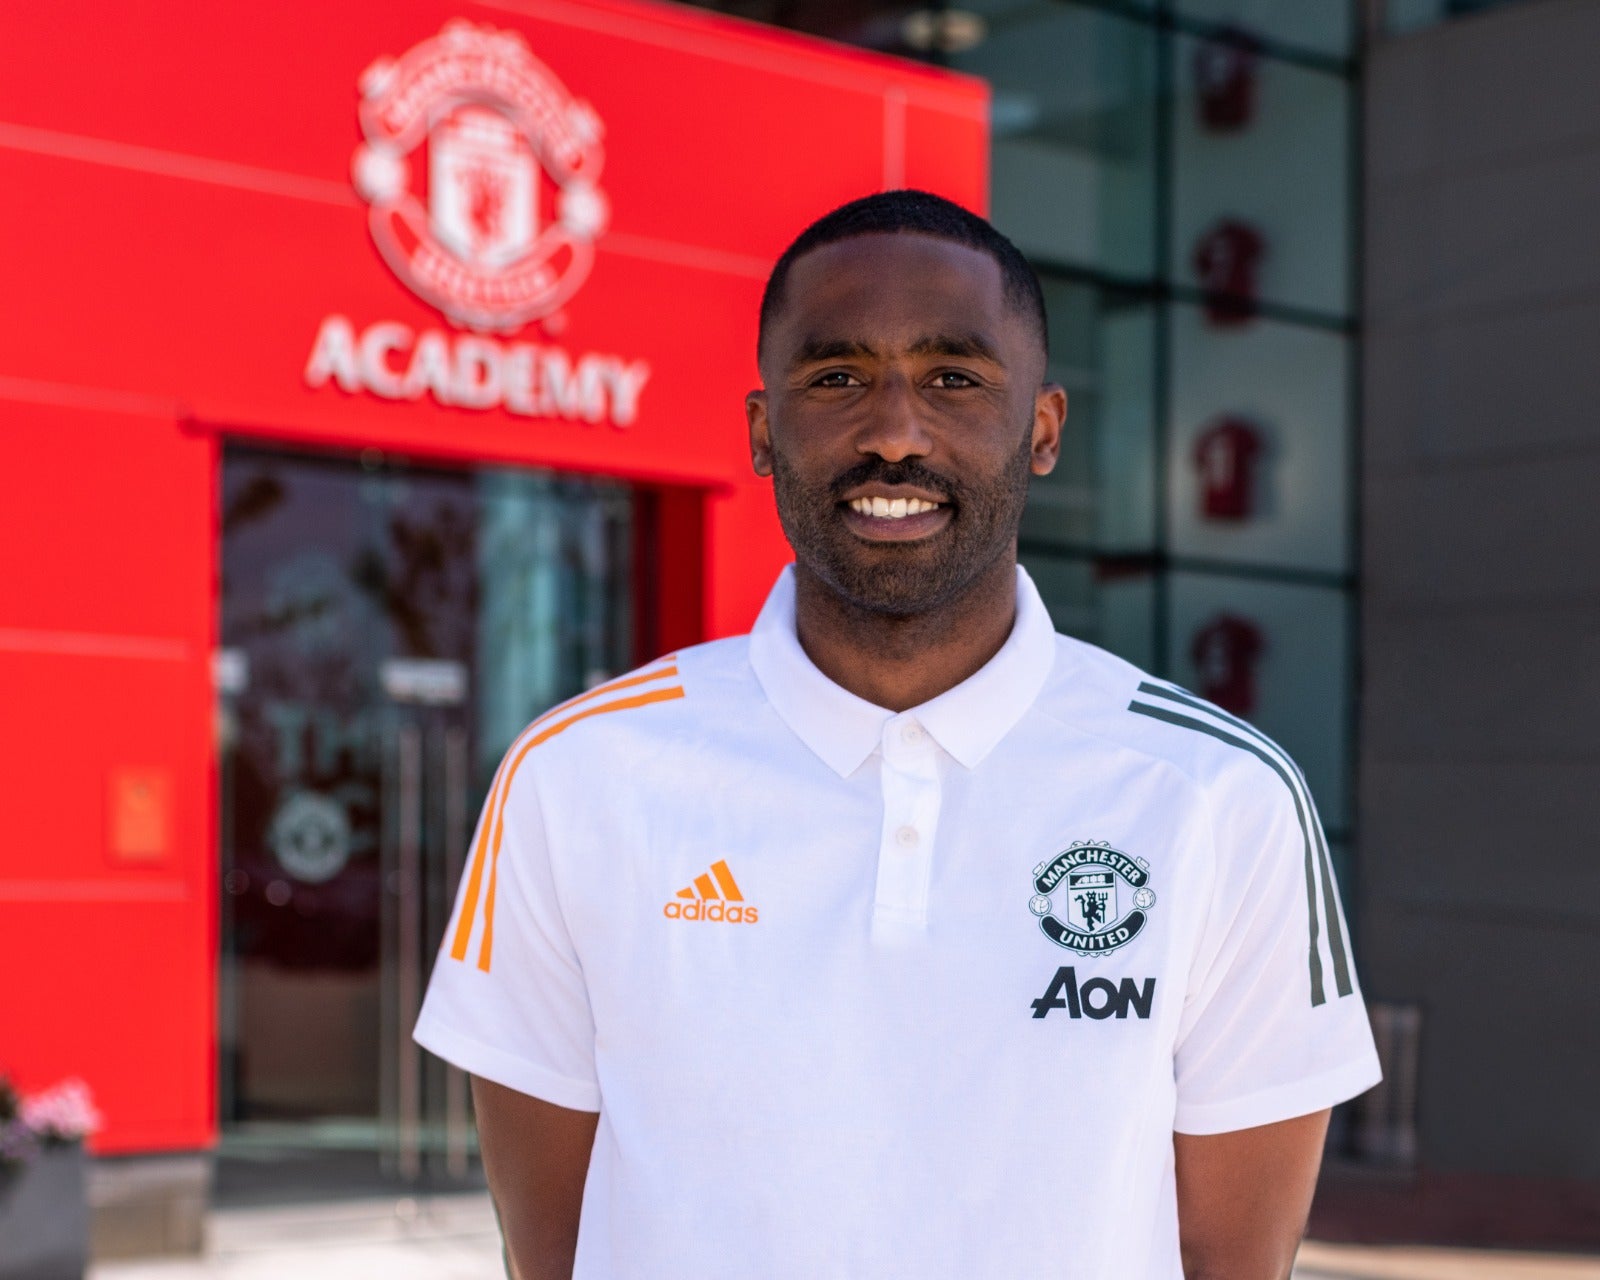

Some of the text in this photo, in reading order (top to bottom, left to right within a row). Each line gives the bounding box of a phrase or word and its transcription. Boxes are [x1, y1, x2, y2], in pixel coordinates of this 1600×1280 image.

[306, 315, 649, 426] ACADEMY
[1042, 850, 1141, 888] MANCHESTER
[663, 899, 759, 924] adidas
[1059, 927, 1130, 949] UNITED
